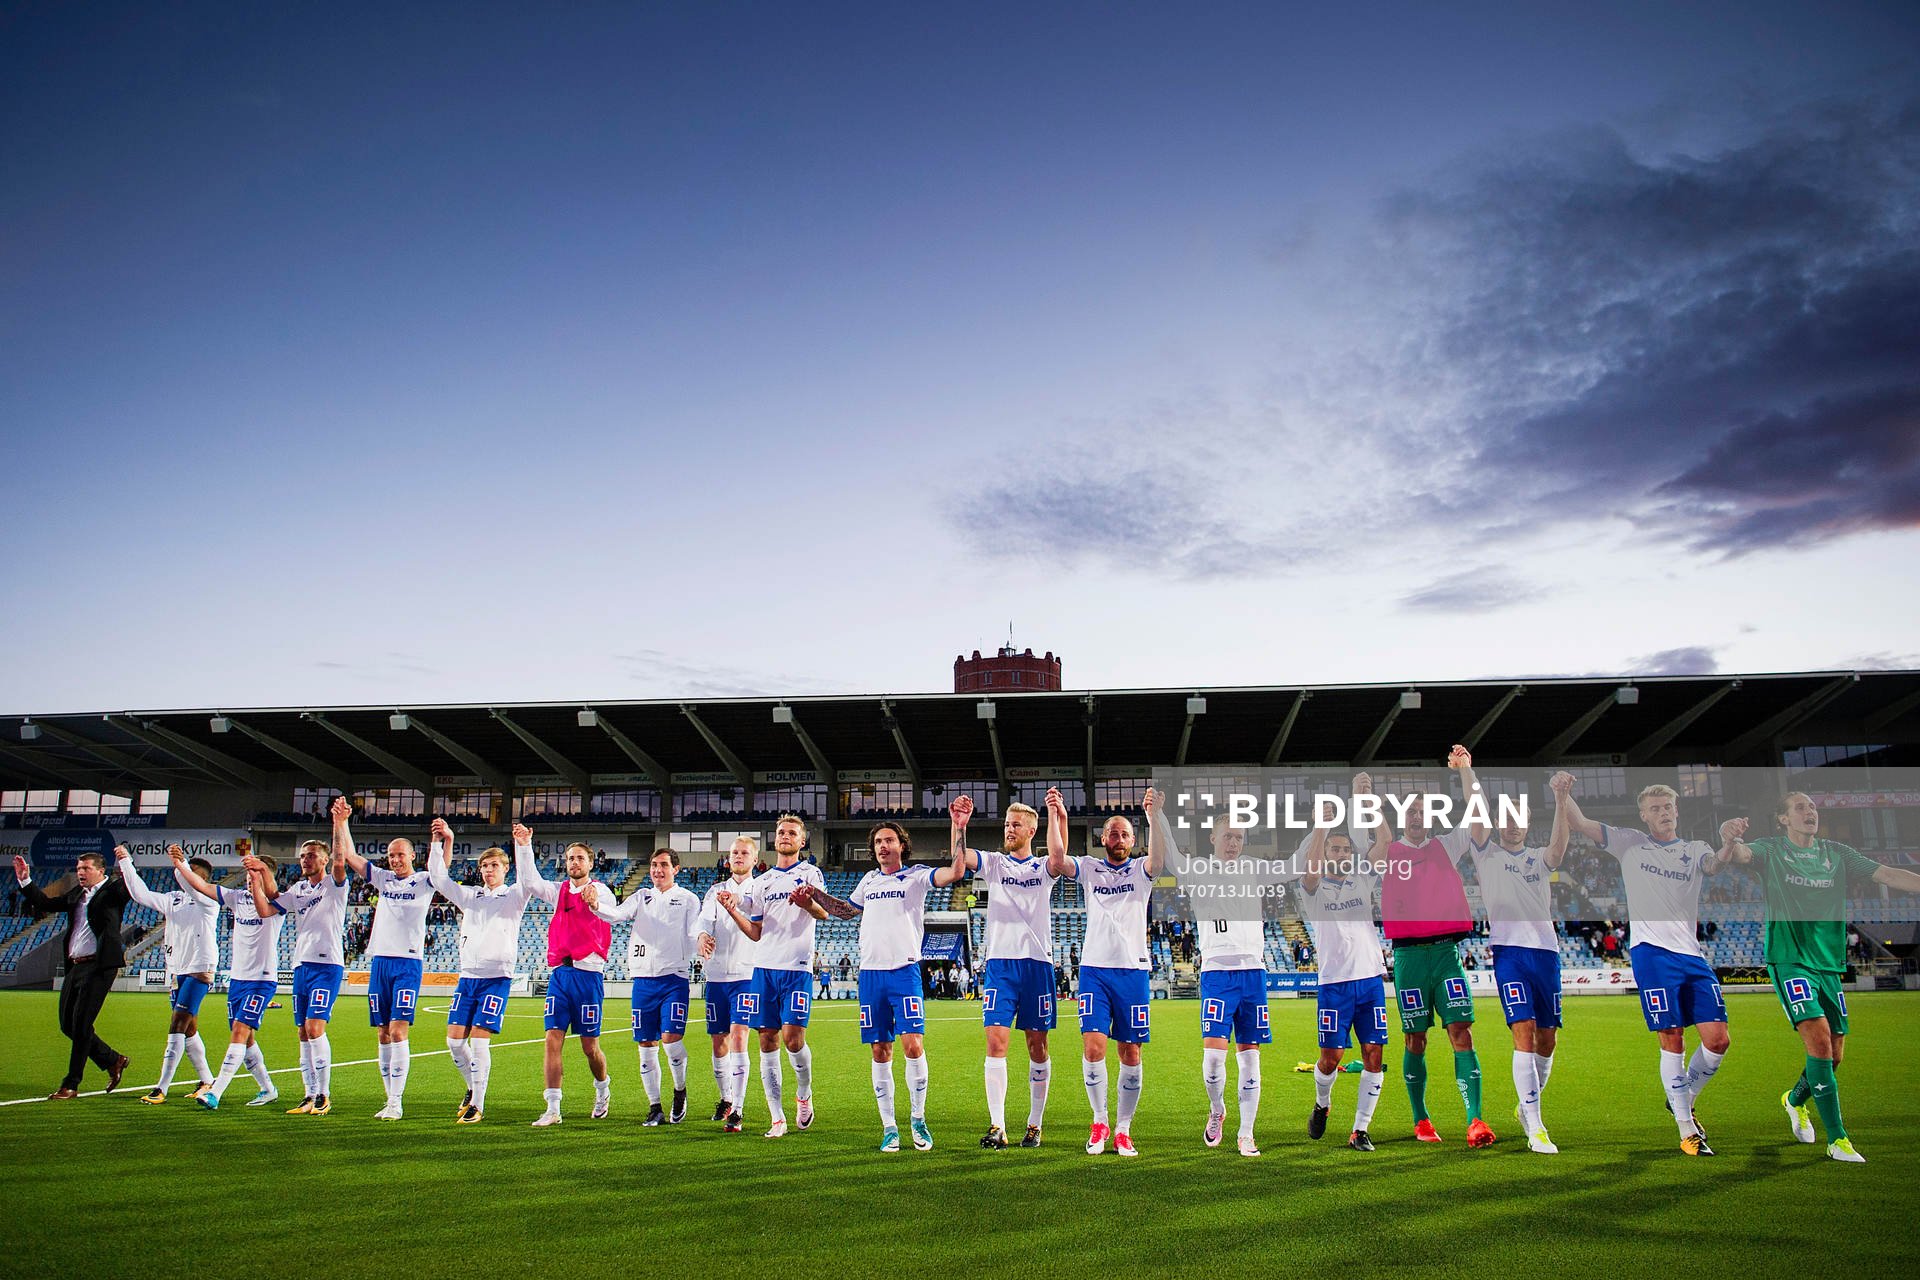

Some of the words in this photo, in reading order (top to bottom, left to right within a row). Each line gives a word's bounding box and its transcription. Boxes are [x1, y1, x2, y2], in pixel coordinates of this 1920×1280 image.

[766, 772, 816, 781] HOLMEN
[1009, 769, 1040, 777] Canon
[103, 815, 152, 827] Folkpool
[120, 840, 170, 855] Svensk
[182, 840, 231, 858] kyrkan
[1640, 862, 1692, 882] HOLMEN
[1001, 876, 1042, 888] HOLMEN
[1785, 873, 1834, 888] HOLMEN
[1093, 883, 1135, 895] HOLMEN
[865, 891, 905, 901] HOLMEN
[1212, 918, 1228, 934] 10
[633, 944, 646, 957] 30
[1508, 1006, 1514, 1018] 3
[1202, 1021, 1211, 1032] 18
